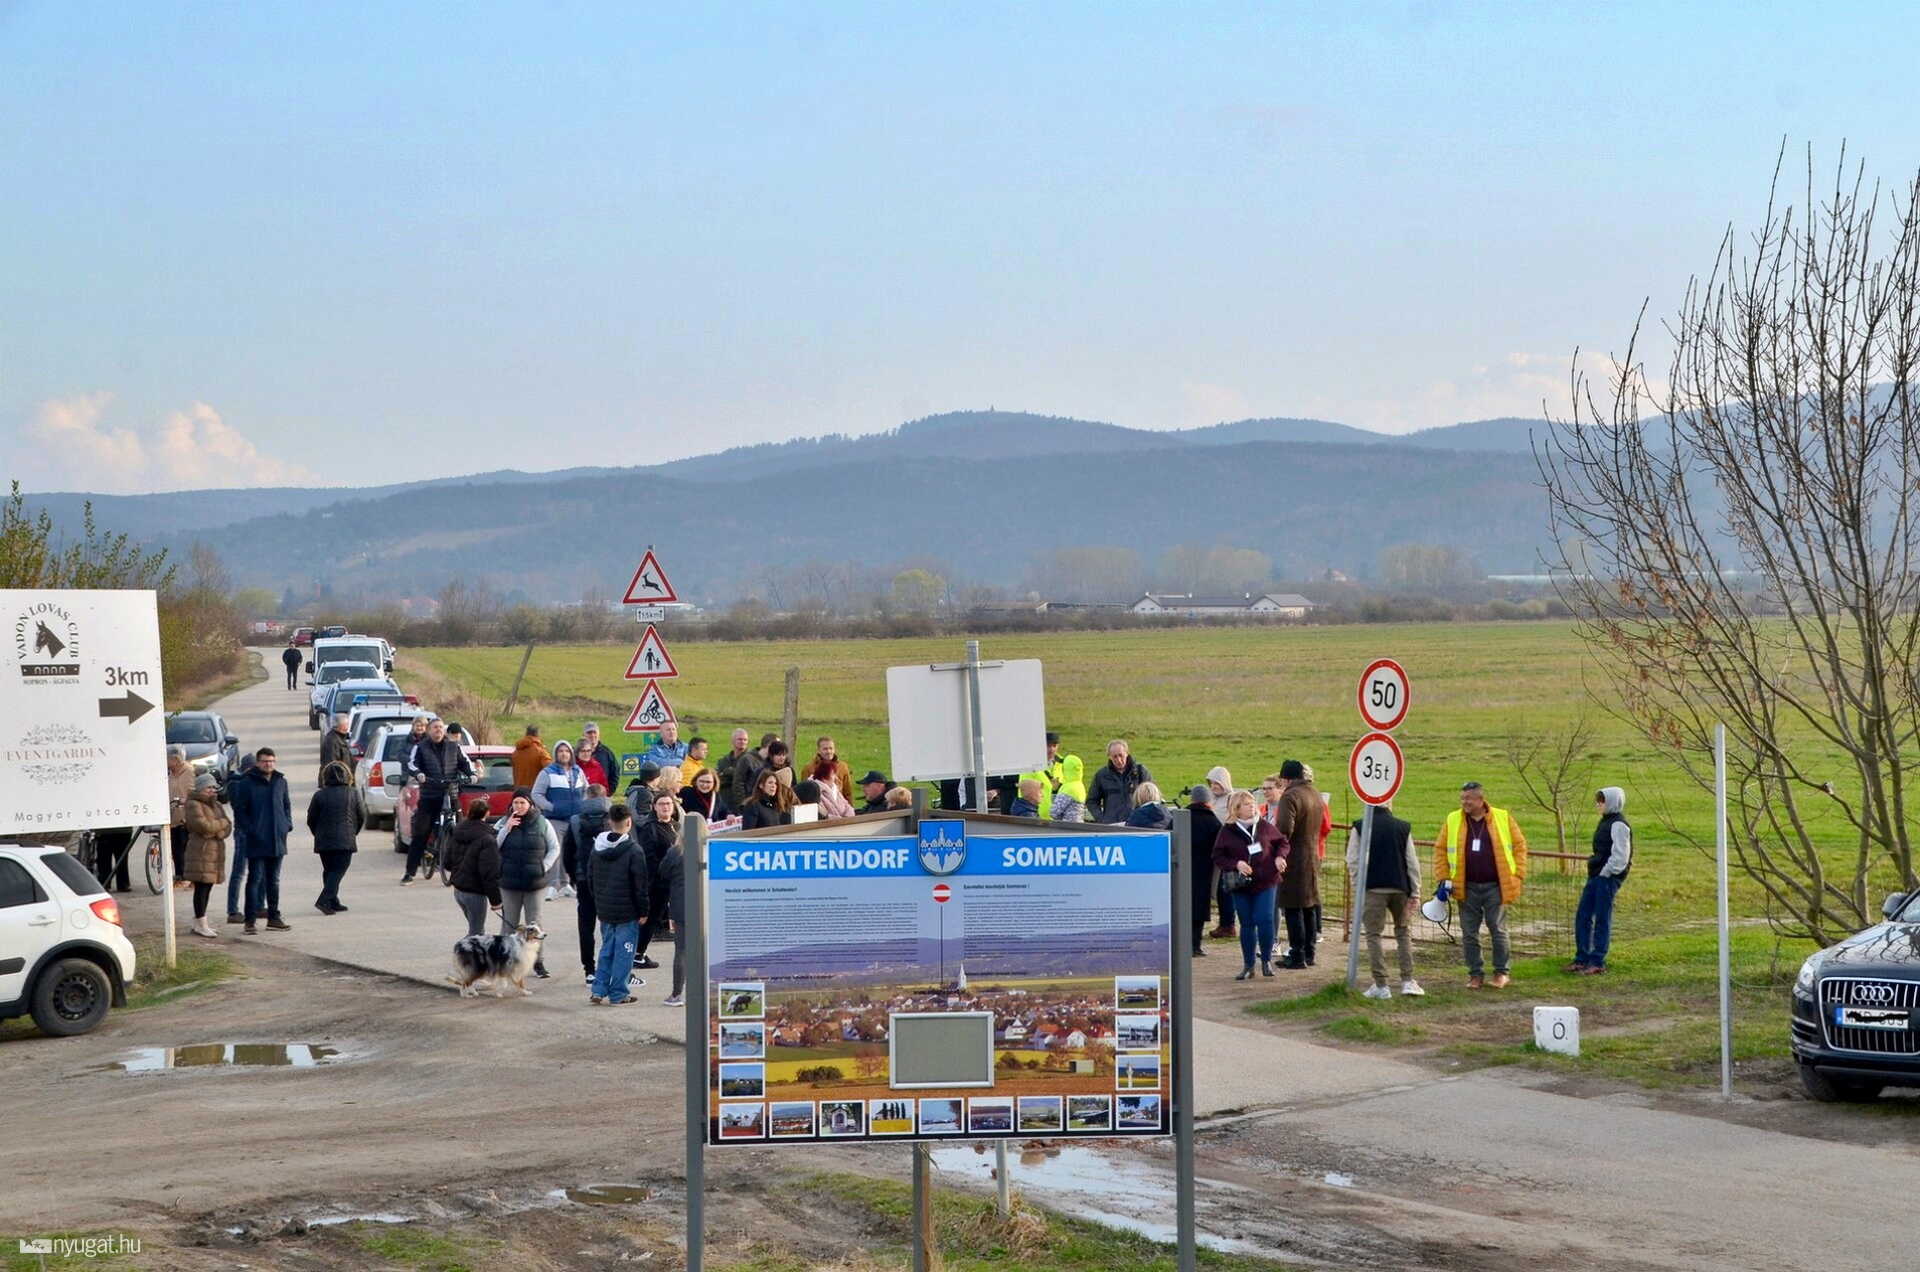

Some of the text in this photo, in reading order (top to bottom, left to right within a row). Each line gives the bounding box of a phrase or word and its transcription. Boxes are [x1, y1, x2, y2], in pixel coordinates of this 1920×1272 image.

[16, 602, 80, 660] VADON LOVAS CLUB
[105, 666, 149, 686] 3km
[1372, 680, 1397, 709] 50
[14, 809, 72, 824] Magyar
[86, 807, 121, 818] utca
[725, 848, 909, 873] SCHATTENDORF
[1002, 846, 1127, 868] SOMFALVA
